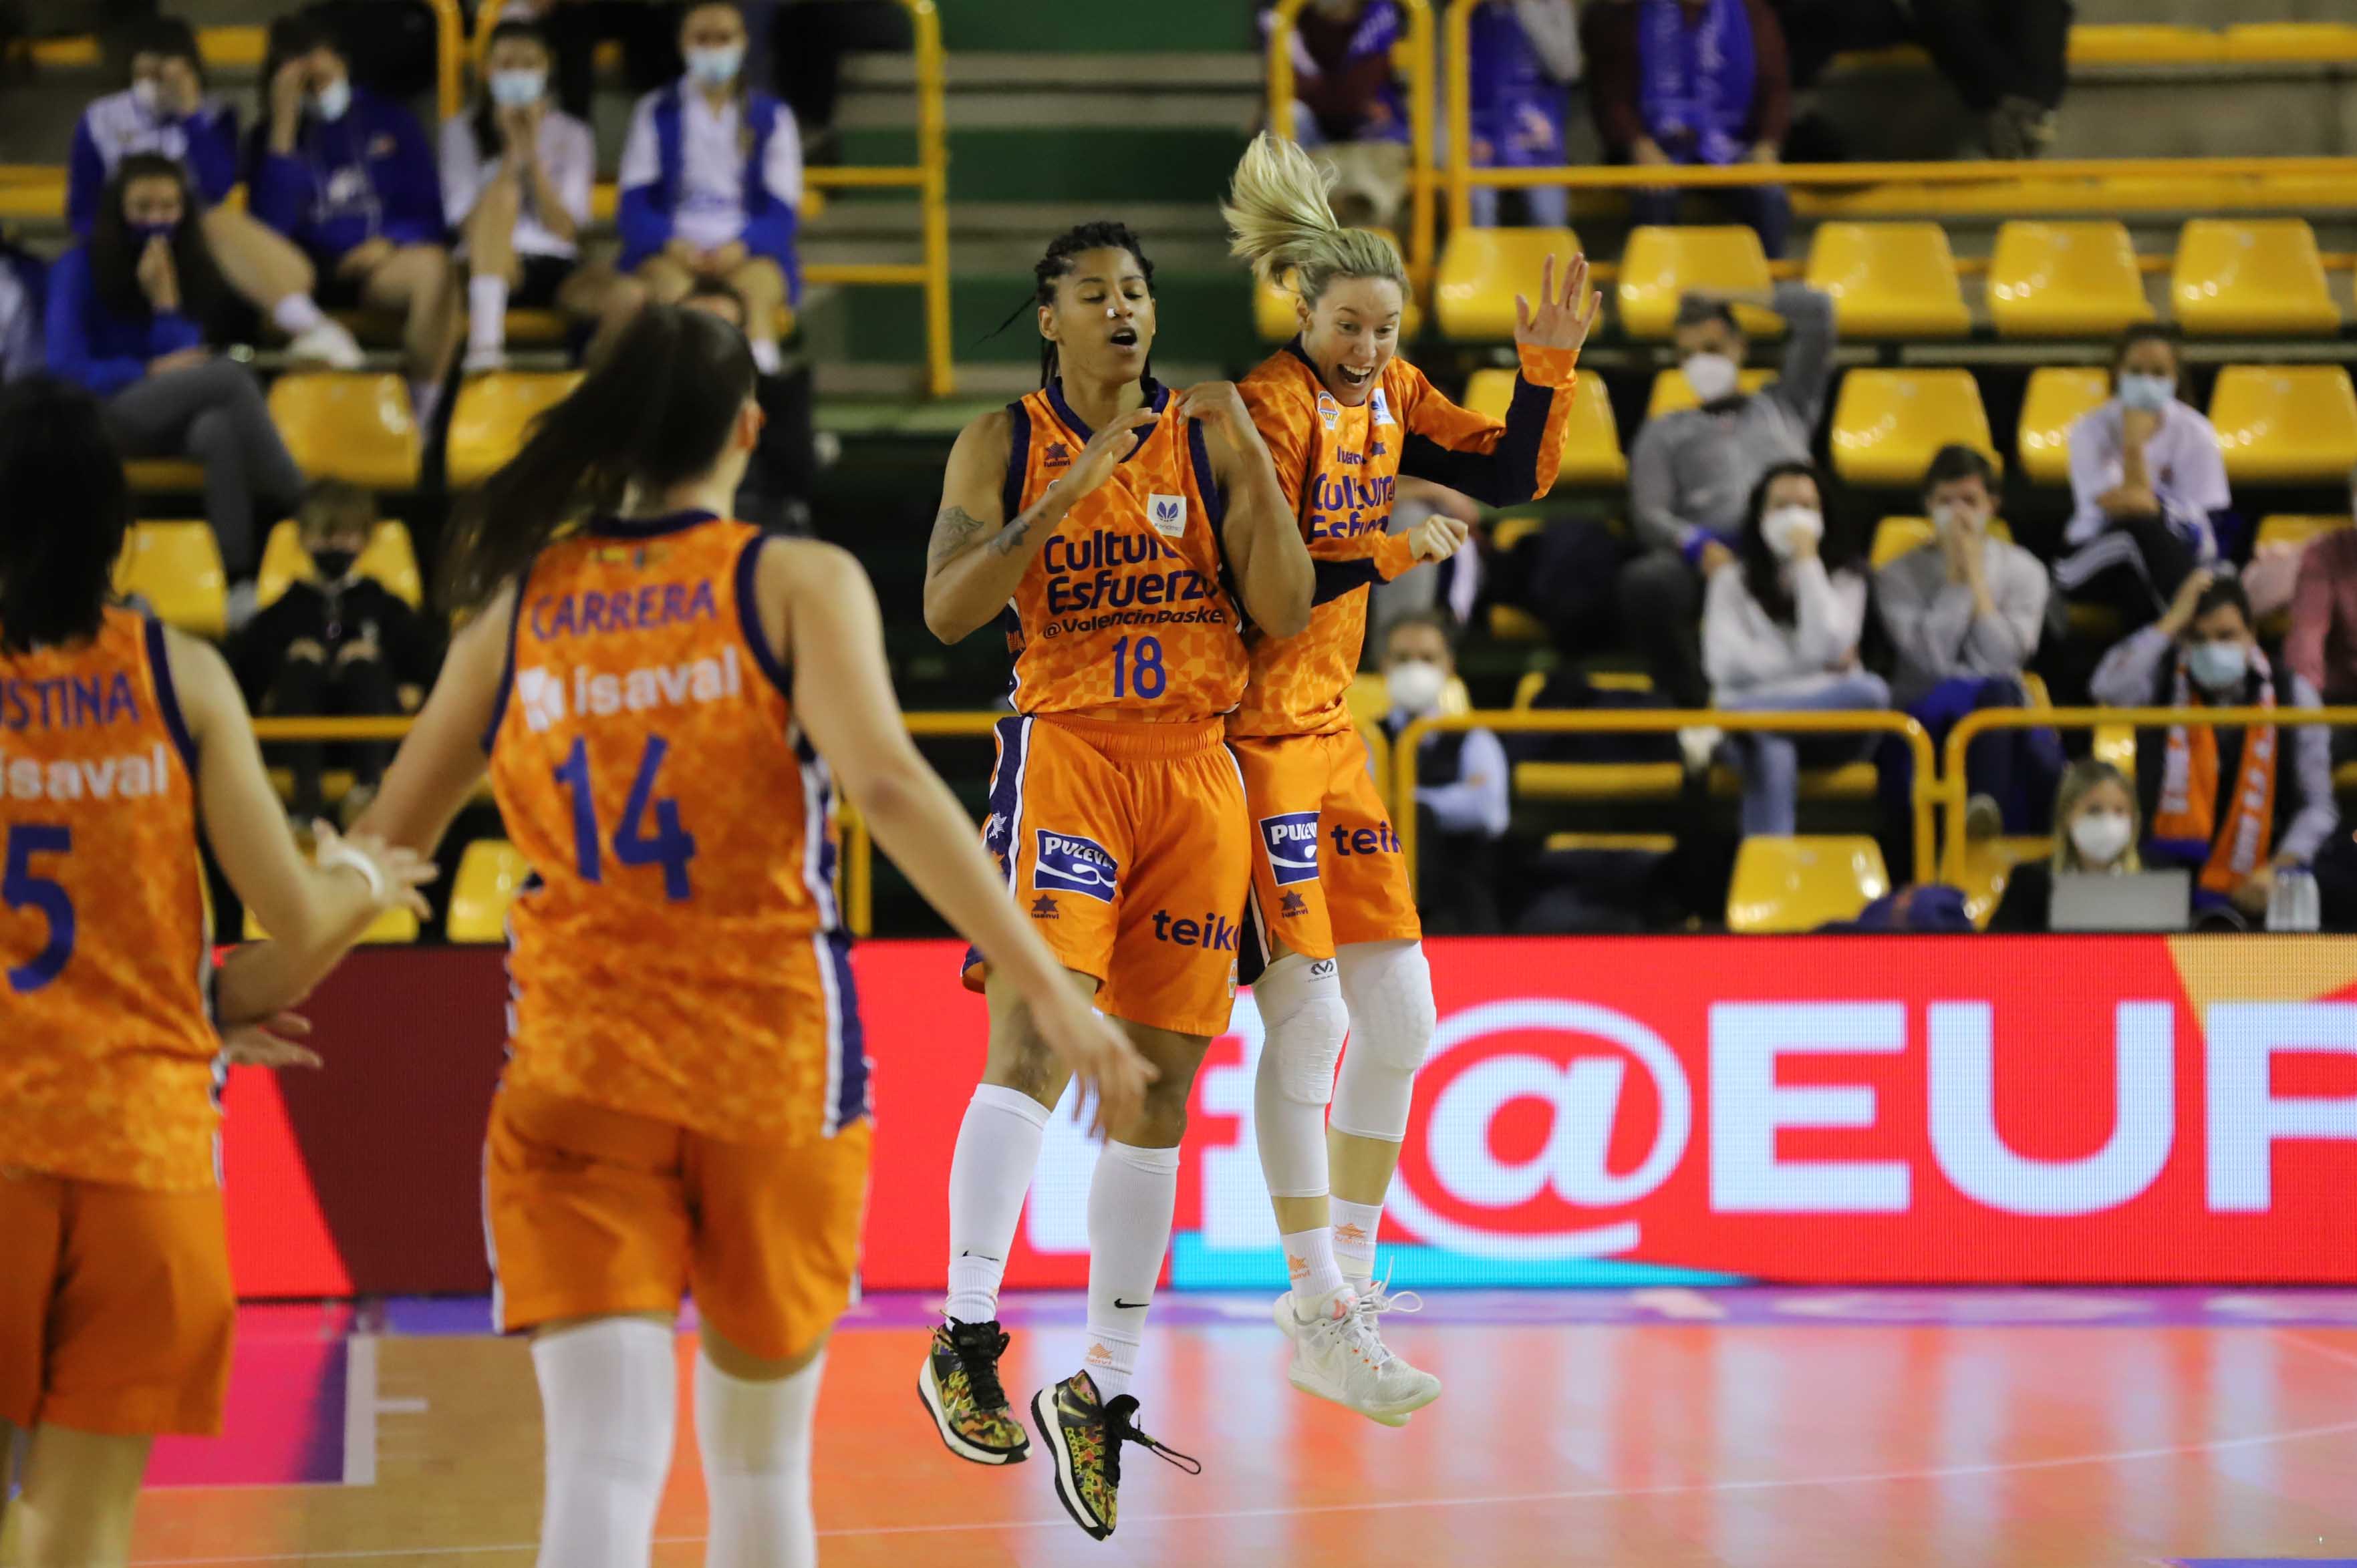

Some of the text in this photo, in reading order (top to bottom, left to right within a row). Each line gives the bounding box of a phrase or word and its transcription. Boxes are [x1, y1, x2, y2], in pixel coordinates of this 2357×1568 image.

[531, 579, 716, 641] CARRERA
[574, 643, 741, 716] isaval
[1112, 635, 1167, 699] 18
[553, 732, 696, 902] 14
[1, 823, 76, 995] 5
